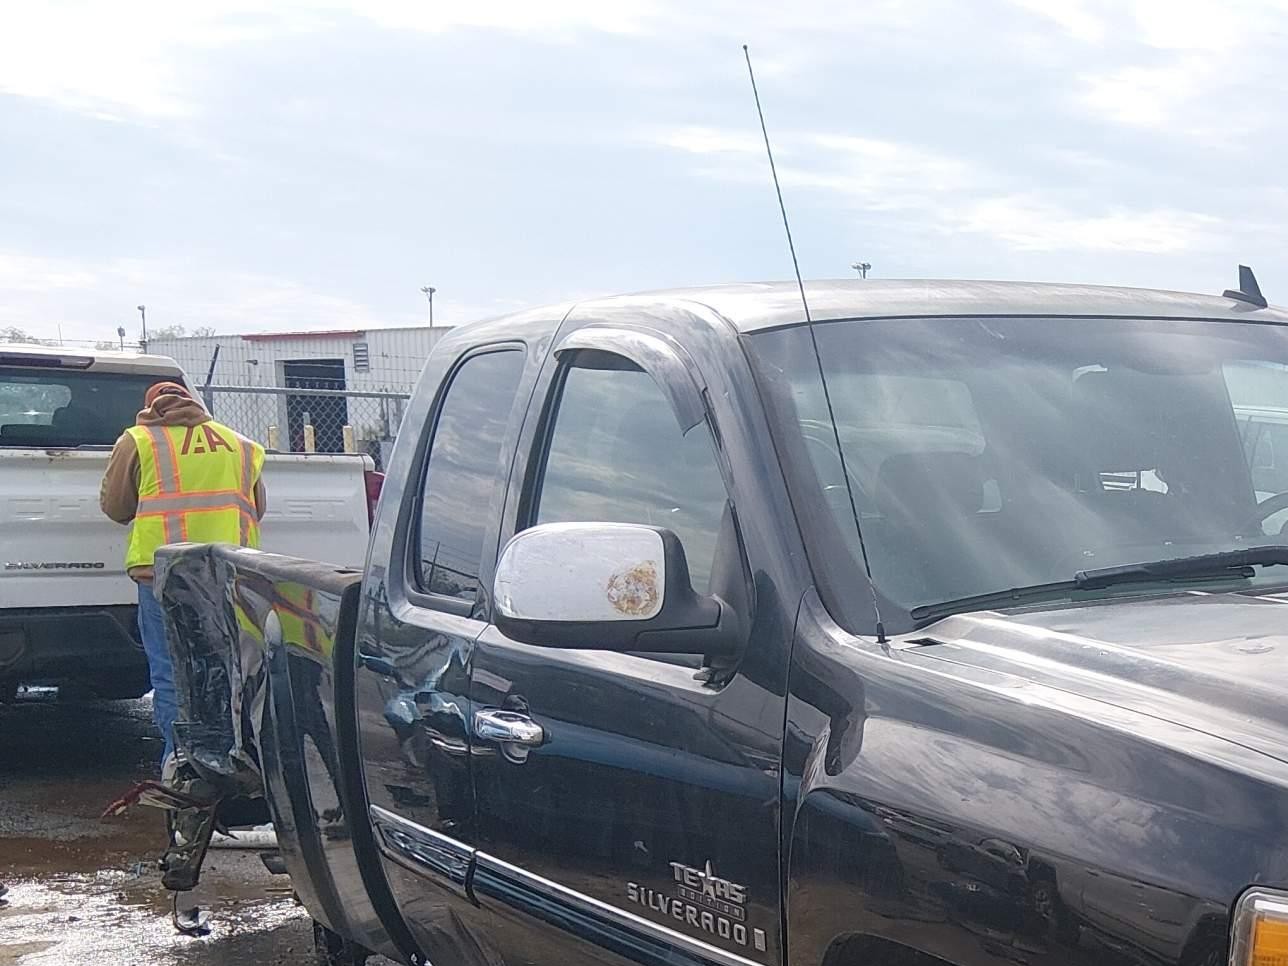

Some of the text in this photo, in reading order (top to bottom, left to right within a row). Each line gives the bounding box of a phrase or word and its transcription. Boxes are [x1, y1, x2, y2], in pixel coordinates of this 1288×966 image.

[4, 561, 105, 570] SILVERADO
[669, 860, 747, 904] TEXAS
[626, 882, 748, 946] SILVERADO
